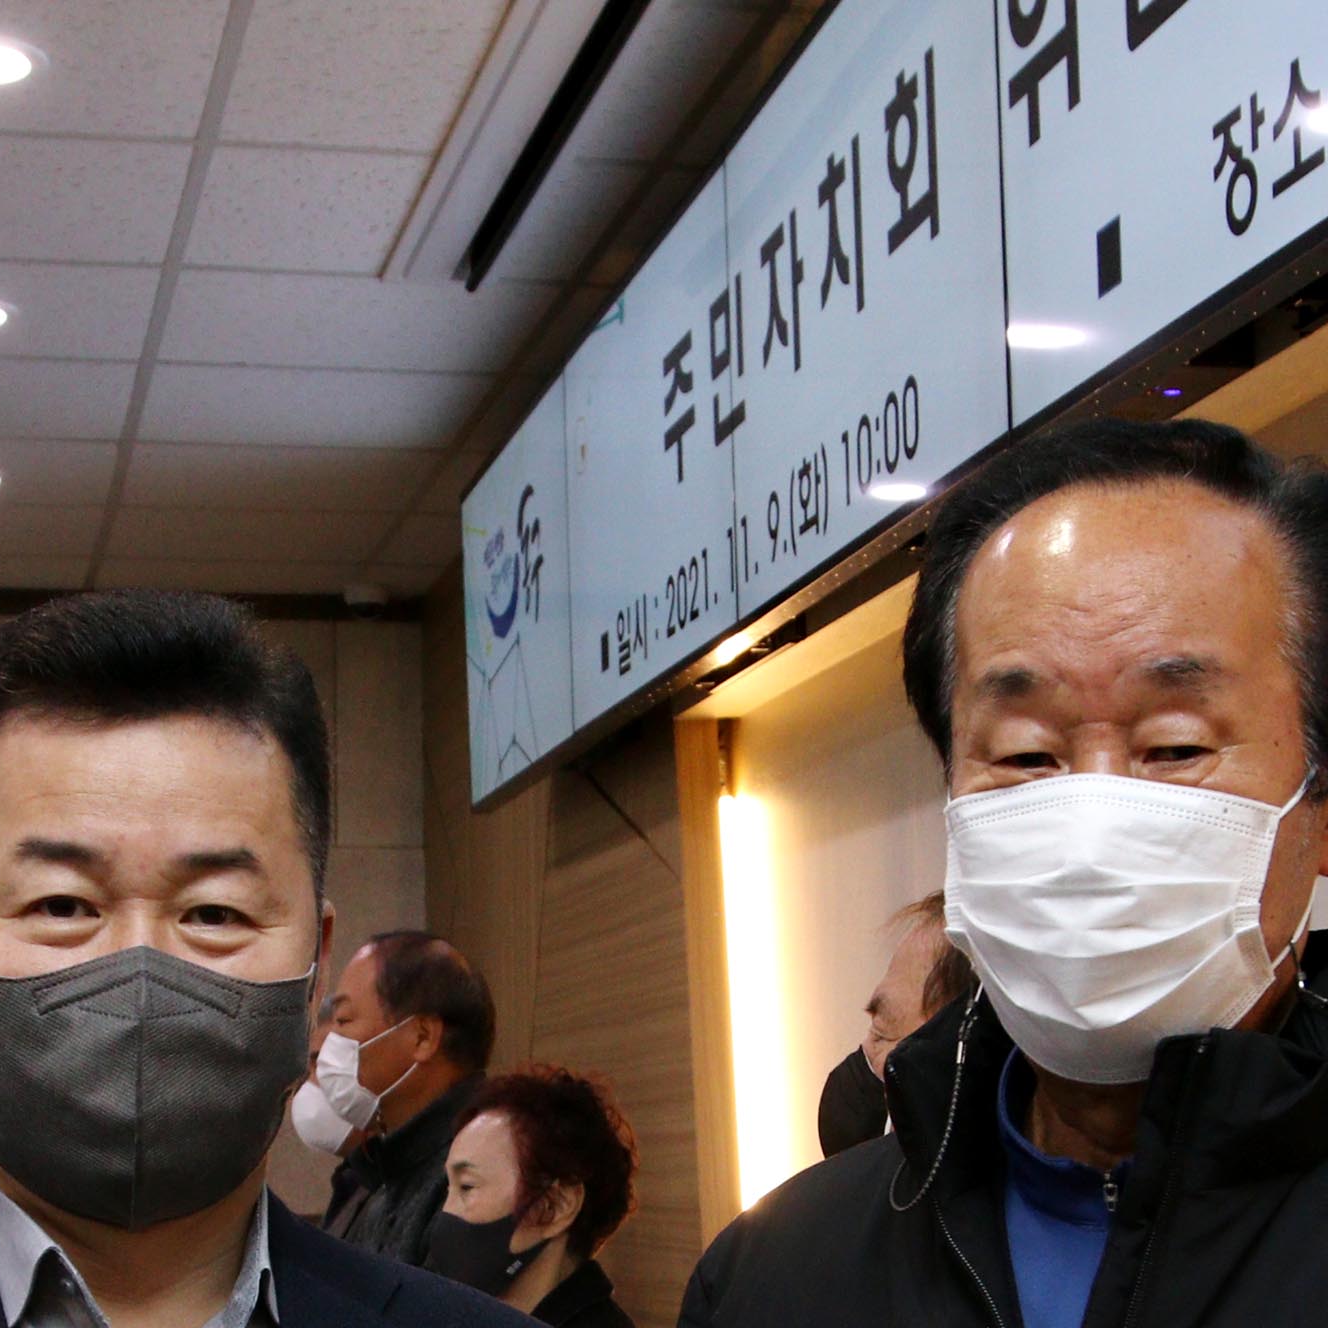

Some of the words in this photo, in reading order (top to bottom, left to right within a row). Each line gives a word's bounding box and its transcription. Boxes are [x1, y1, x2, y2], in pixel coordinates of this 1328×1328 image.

[1213, 57, 1325, 237] 장소
[662, 44, 941, 484] 주민자치회
[1008, 0, 1190, 148] 위
[841, 374, 920, 507] 10:00
